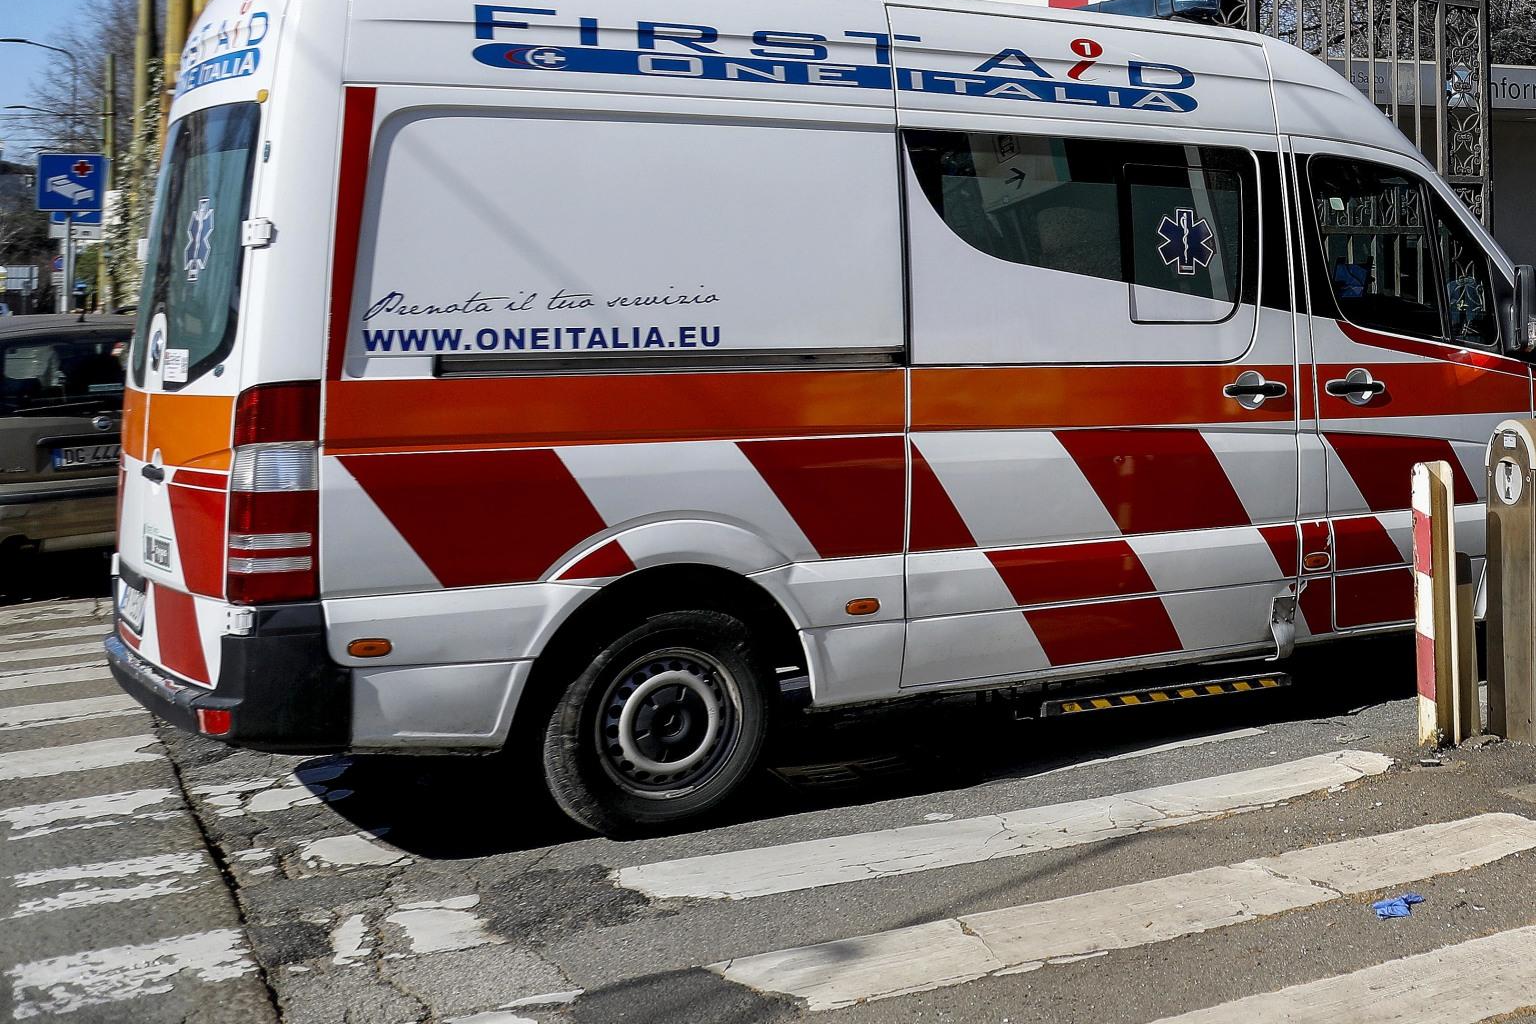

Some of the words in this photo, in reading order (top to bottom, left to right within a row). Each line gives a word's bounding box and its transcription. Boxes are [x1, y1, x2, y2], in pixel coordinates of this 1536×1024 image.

[474, 3, 922, 66] FIRST
[197, 52, 255, 86] ITALIA
[637, 54, 859, 86] ONE
[910, 70, 1185, 113] ITALIA
[363, 290, 503, 322] Prenota
[505, 290, 534, 313] il
[547, 288, 595, 310] tuo
[606, 284, 721, 309] servizio
[361, 325, 721, 352] WWW.ONEITALIA.EU
[64, 449, 86, 464] DG
